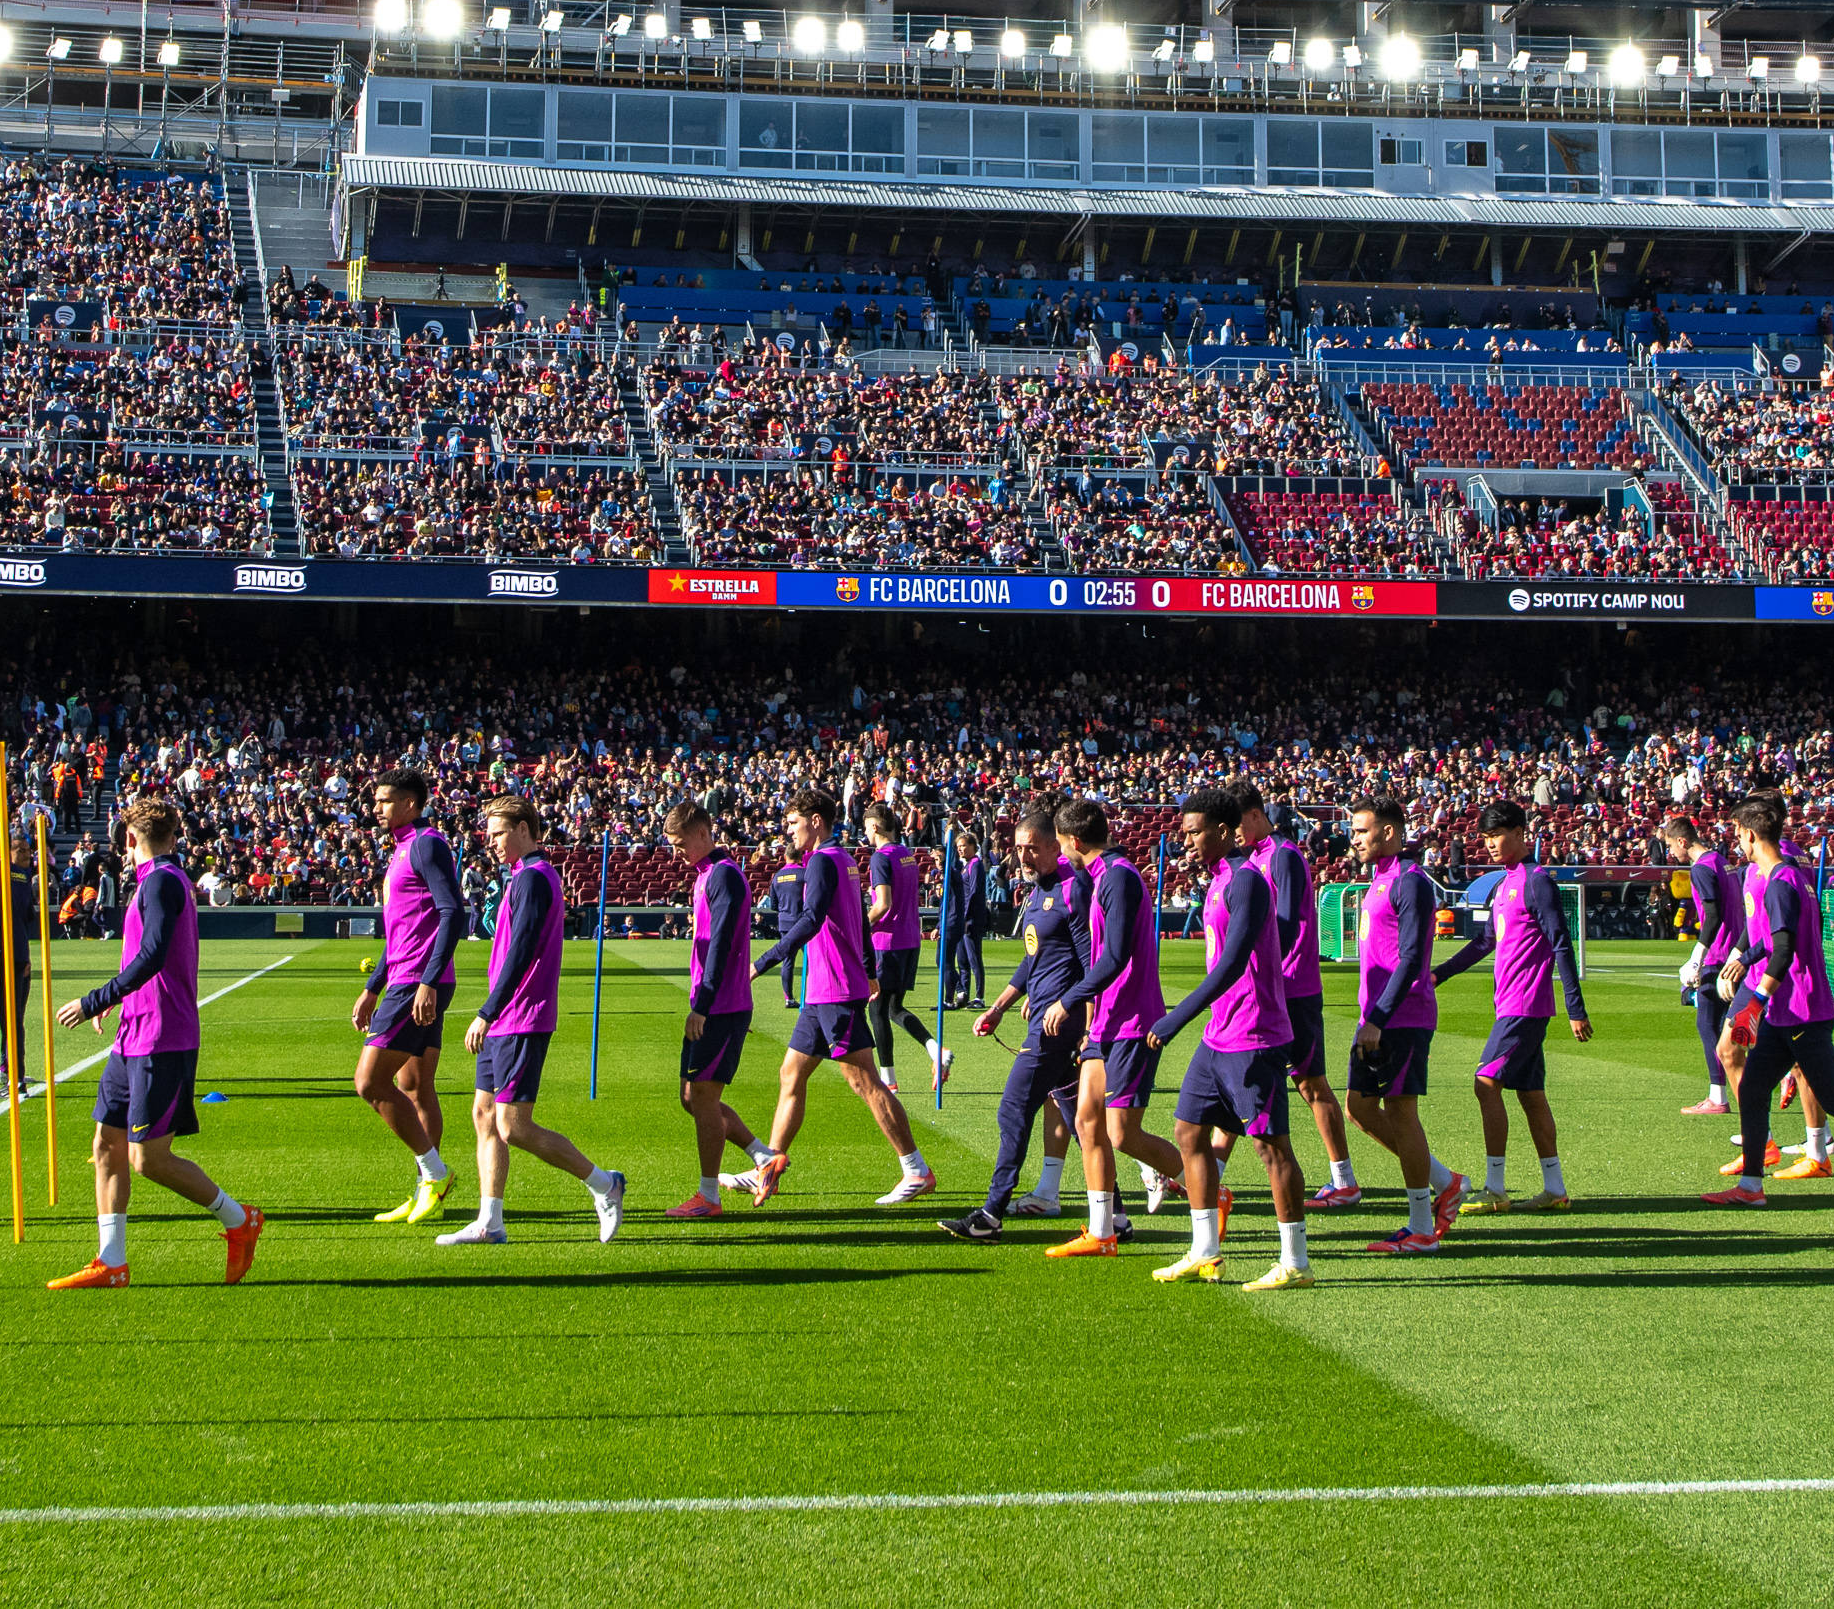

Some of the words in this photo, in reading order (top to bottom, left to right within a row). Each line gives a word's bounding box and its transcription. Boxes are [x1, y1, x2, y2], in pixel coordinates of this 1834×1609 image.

[236, 569, 306, 587] BIMBO
[491, 574, 557, 593] BIMBO
[689, 579, 760, 593] ESTRELLA
[711, 593, 738, 601] DAMM
[869, 578, 894, 602] FC
[898, 578, 1011, 604] BARCELONA
[1049, 579, 1068, 606] 0
[1083, 581, 1136, 607] 02:55
[1151, 580, 1171, 609] 0
[1202, 582, 1225, 607] FC
[1230, 582, 1341, 610] BARCELONA
[1532, 592, 1599, 609] SPOTIFY
[1601, 592, 1648, 609] CAMP
[1651, 593, 1685, 610] NOU
